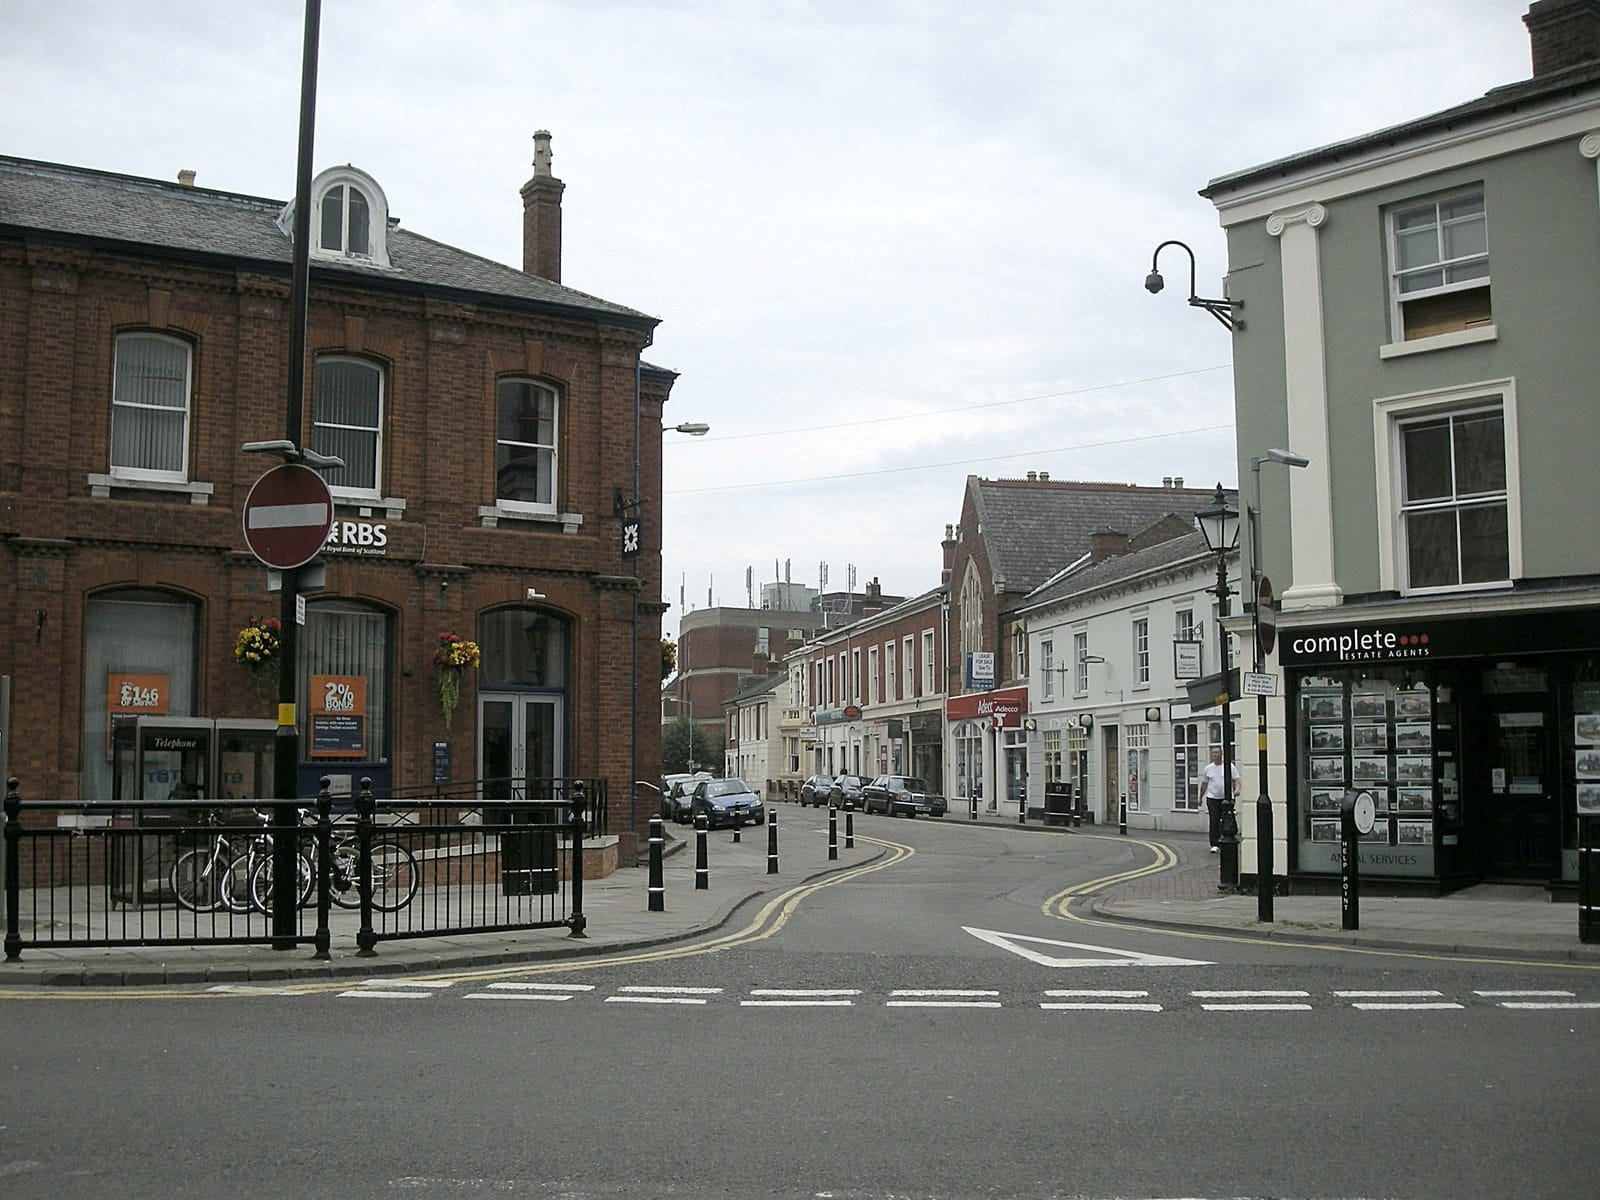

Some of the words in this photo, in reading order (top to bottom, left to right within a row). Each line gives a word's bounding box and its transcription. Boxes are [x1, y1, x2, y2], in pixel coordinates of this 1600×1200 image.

[342, 521, 387, 547] RBS
[326, 545, 342, 554] Royal
[356, 547, 363, 555] of
[363, 548, 386, 556] Scotland
[1293, 629, 1397, 660] complete
[1345, 651, 1382, 660] ESTATE
[1388, 648, 1430, 657] AGENTS
[120, 684, 159, 702] £146
[325, 682, 355, 703] 2%
[326, 700, 354, 709] BONUS
[995, 705, 1019, 713] Adecco
[155, 737, 197, 749] Telephone
[1370, 854, 1417, 865] SERVICES
